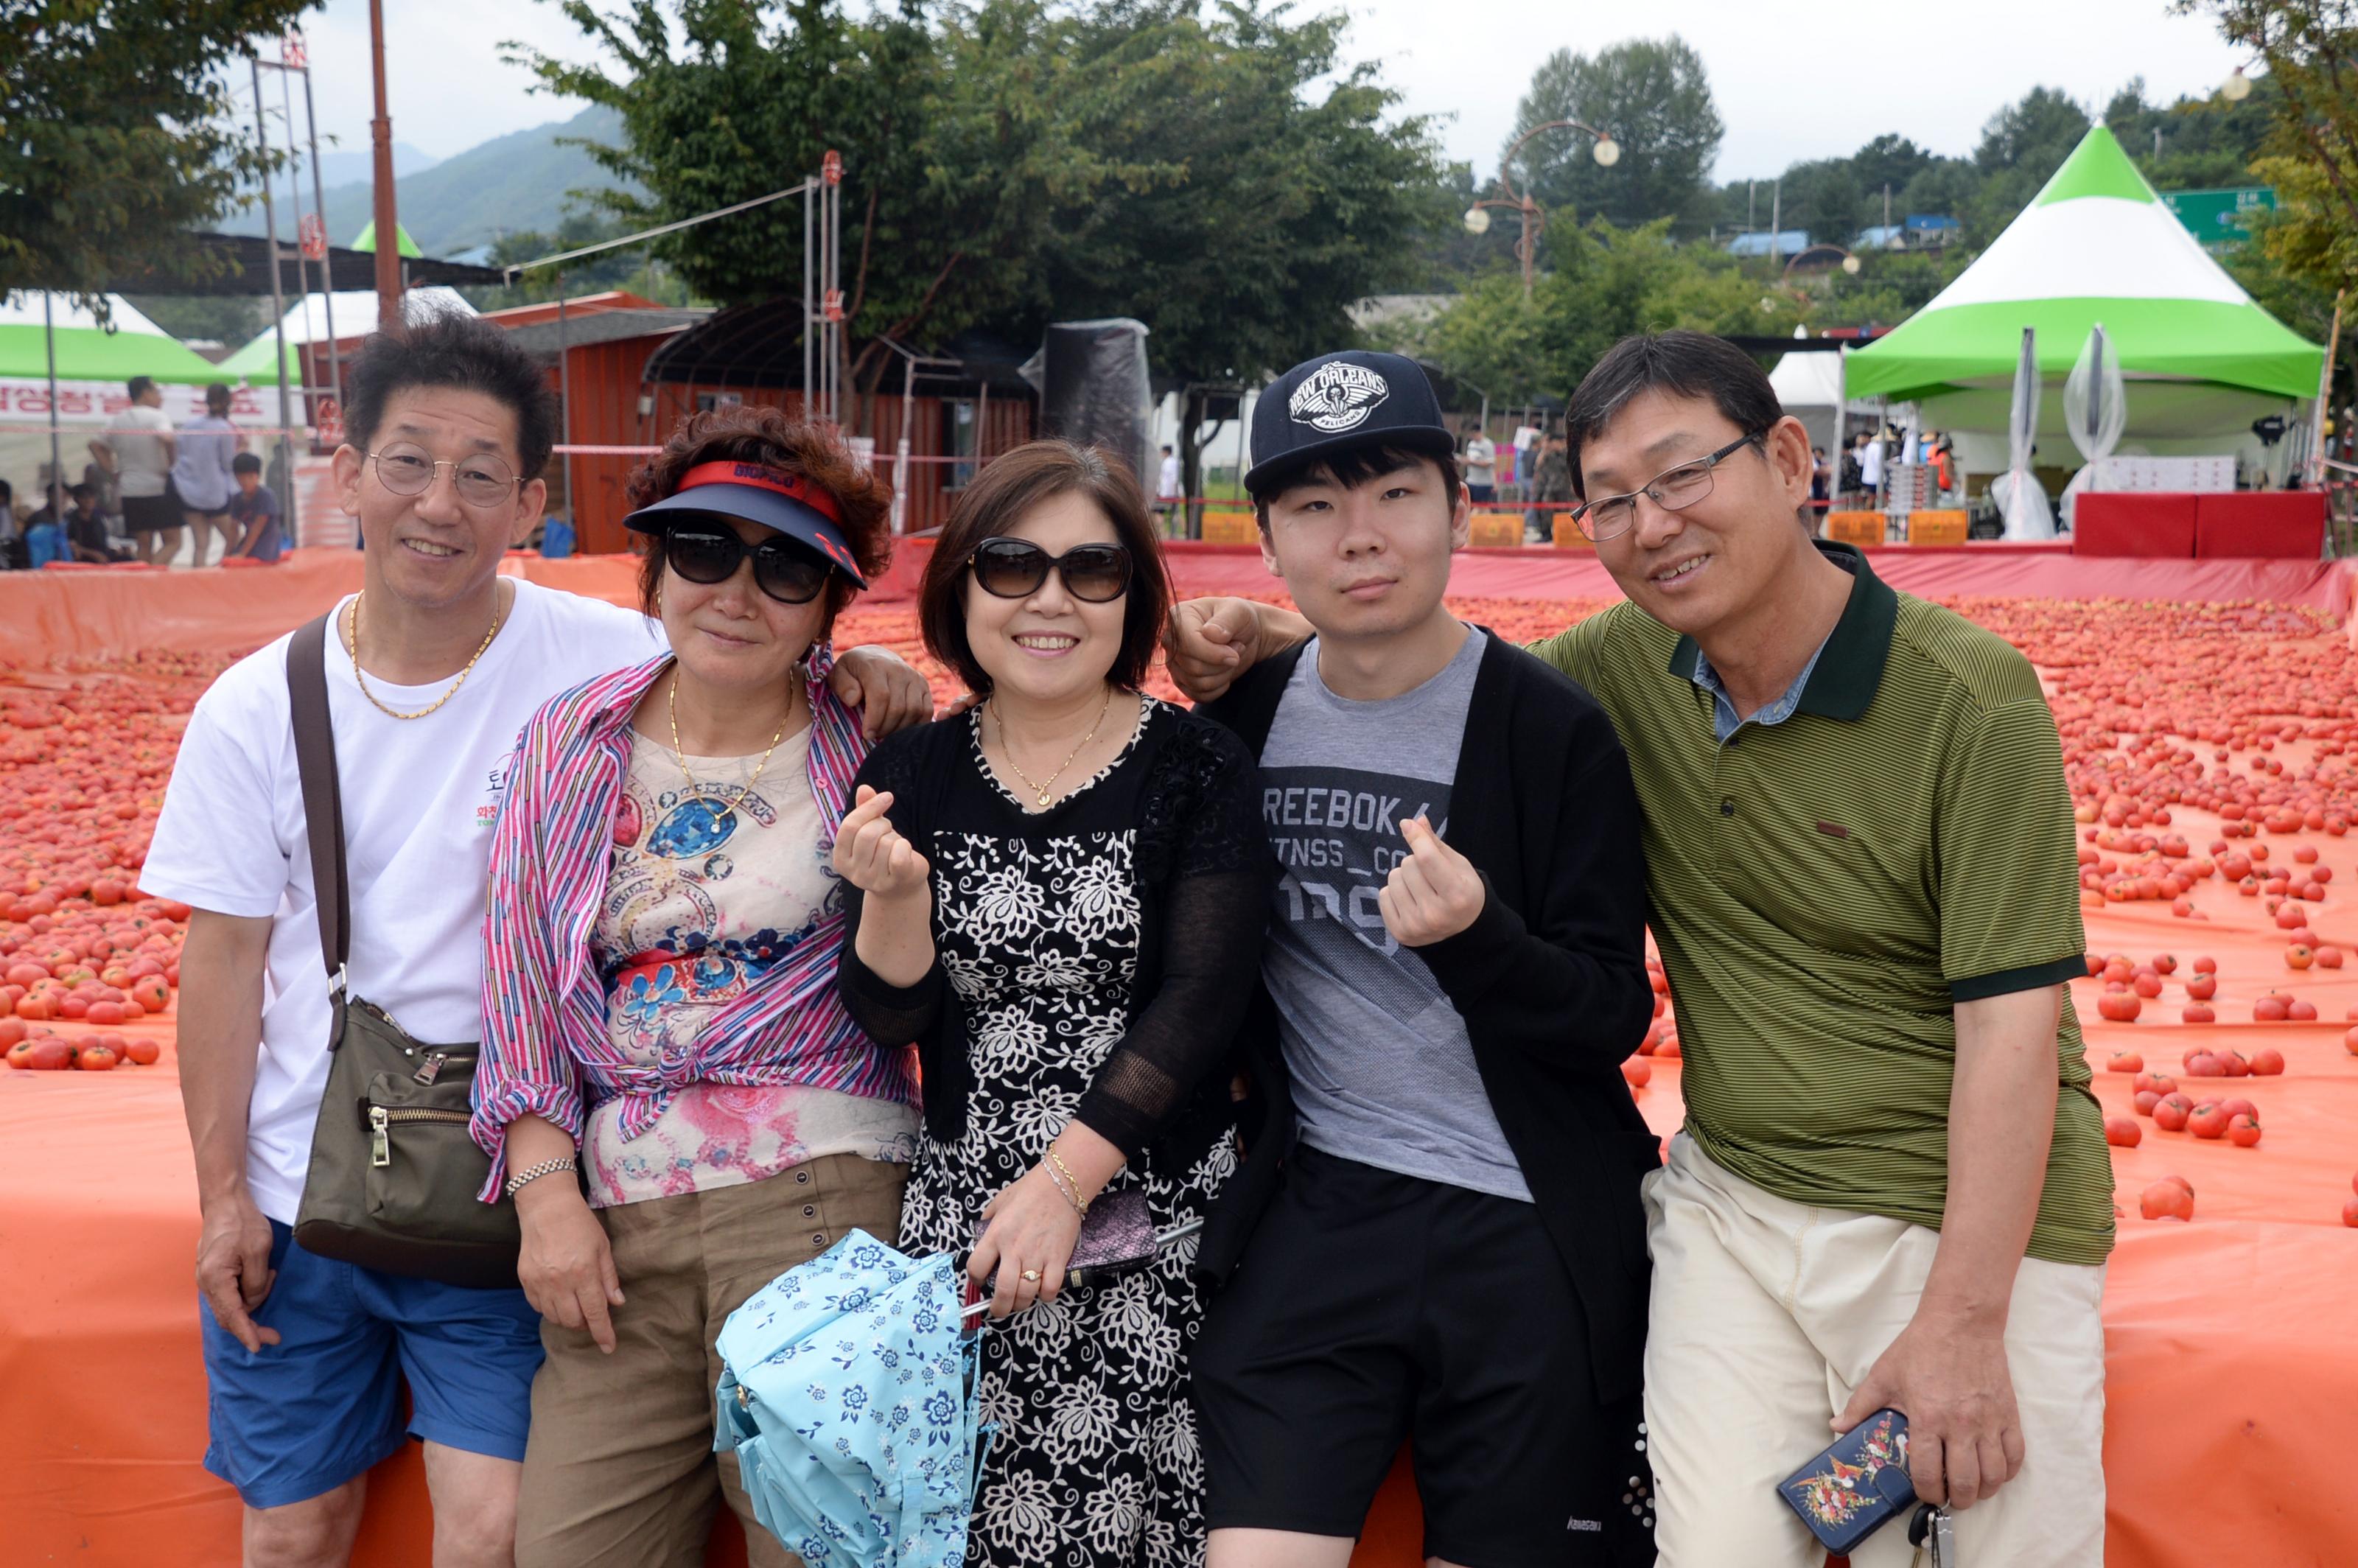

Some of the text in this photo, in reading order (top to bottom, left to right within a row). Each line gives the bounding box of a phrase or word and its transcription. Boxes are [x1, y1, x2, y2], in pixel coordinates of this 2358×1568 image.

[1289, 368, 1386, 413] NEW ORLEANS
[1320, 410, 1361, 427] PELICANS
[1262, 787, 1402, 836] REEBOK
